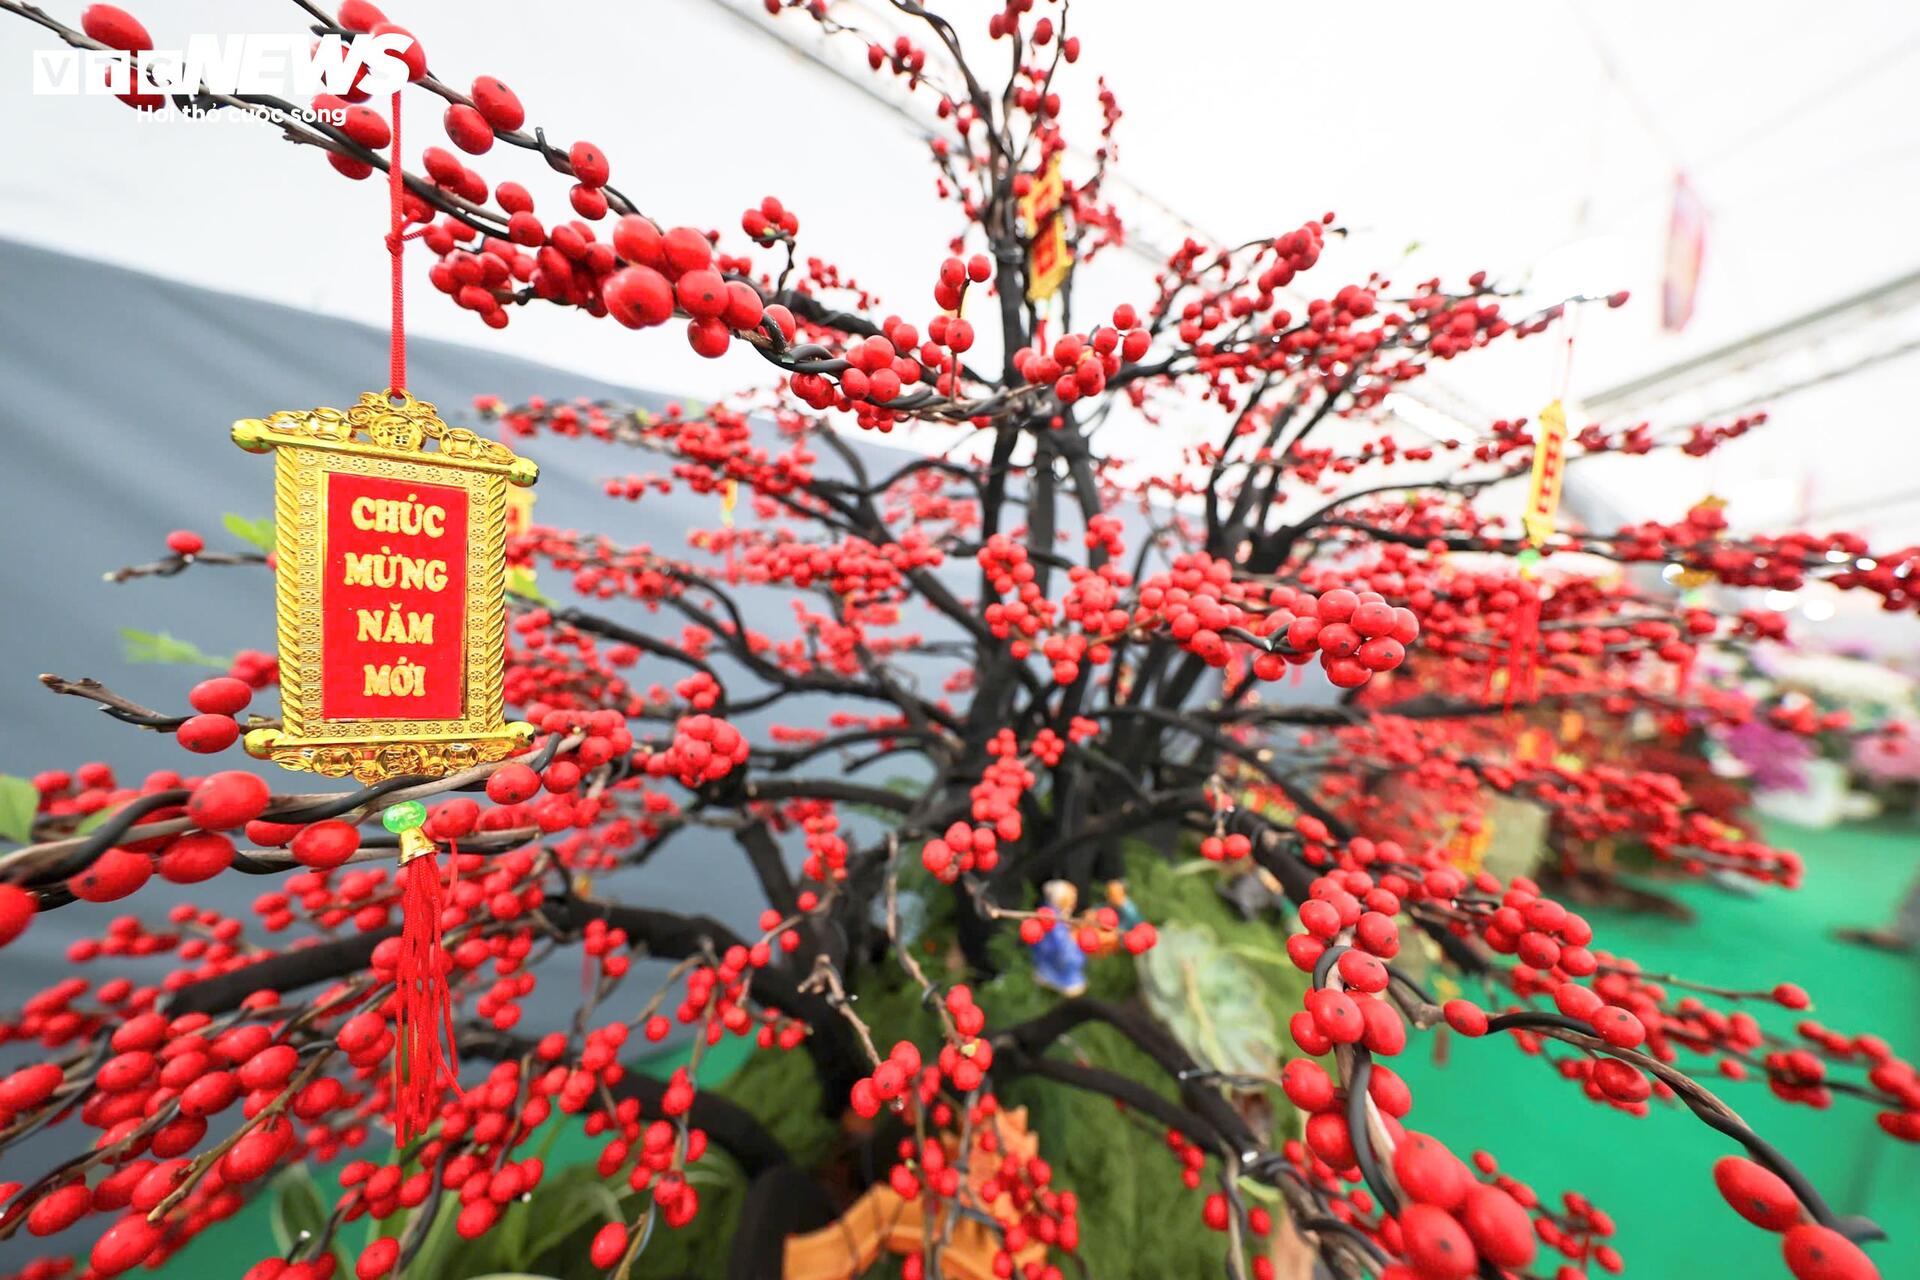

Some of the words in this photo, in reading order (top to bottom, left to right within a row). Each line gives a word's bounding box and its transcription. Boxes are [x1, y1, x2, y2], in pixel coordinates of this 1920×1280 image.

[351, 494, 446, 538] CHÚC
[344, 546, 448, 592] MỪNG
[356, 602, 434, 644] NĂM
[363, 656, 426, 697] MỚI
